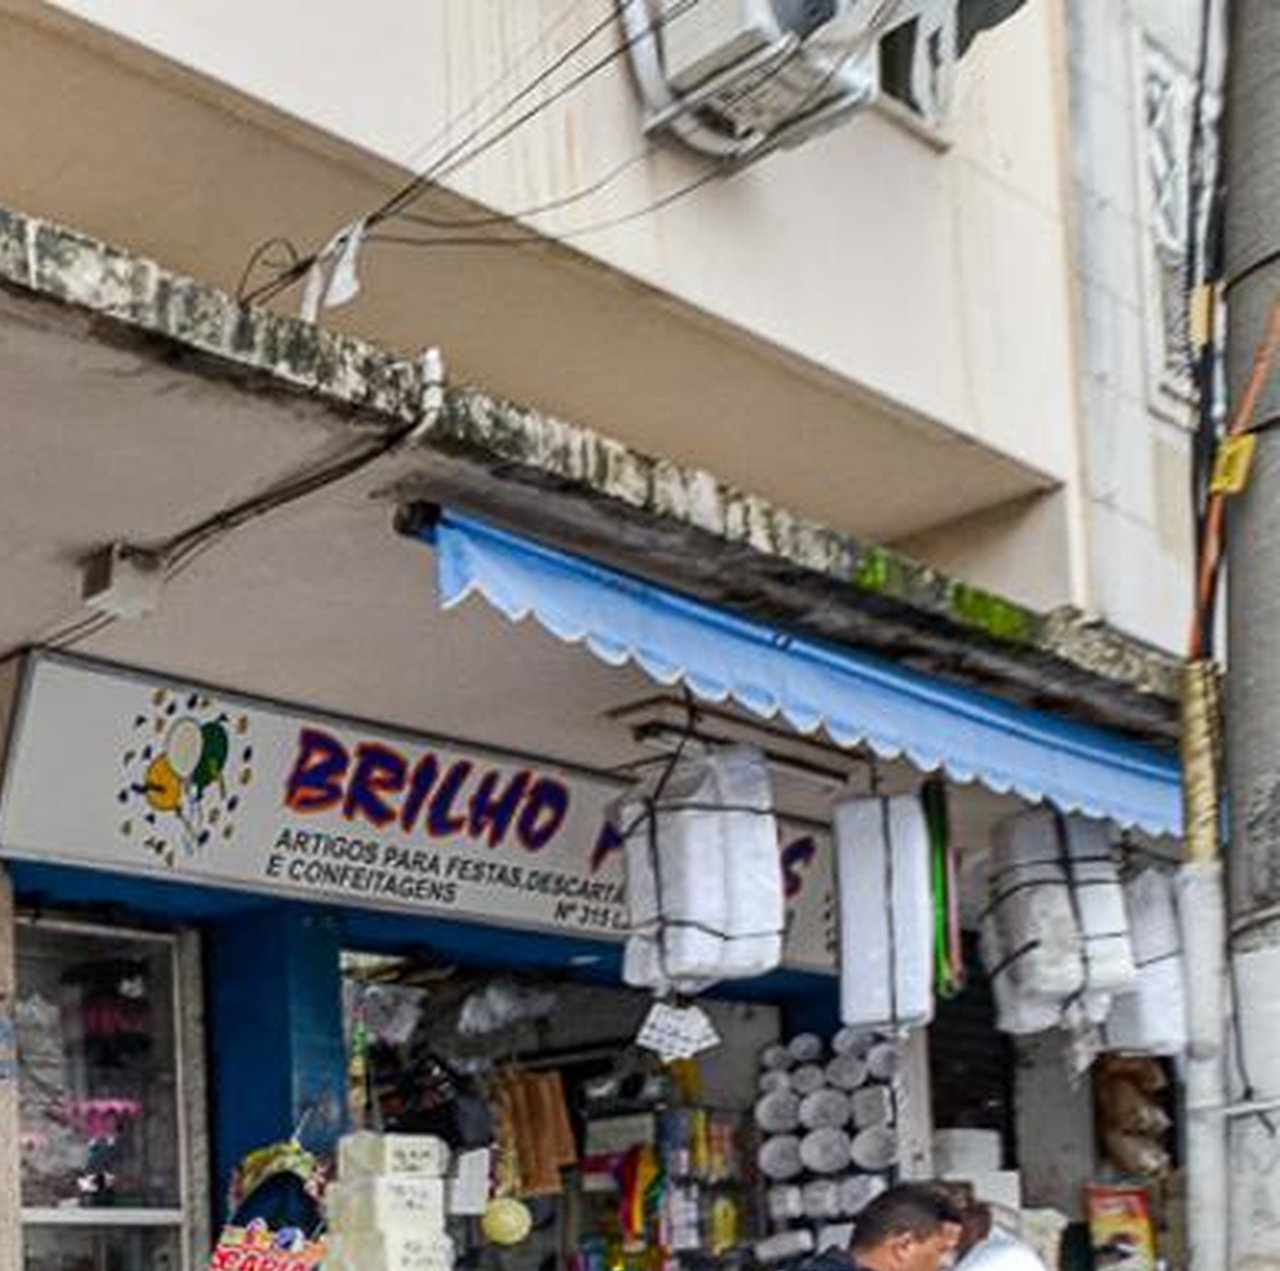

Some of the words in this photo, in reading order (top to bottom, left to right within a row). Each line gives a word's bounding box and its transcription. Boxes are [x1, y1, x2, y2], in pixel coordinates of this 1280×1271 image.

[284, 726, 570, 852] BRILHO
[274, 828, 379, 865] ARTIGOS
[383, 846, 440, 876] PARA
[266, 853, 285, 878] E
[288, 859, 458, 903] CONFEITAGENS
